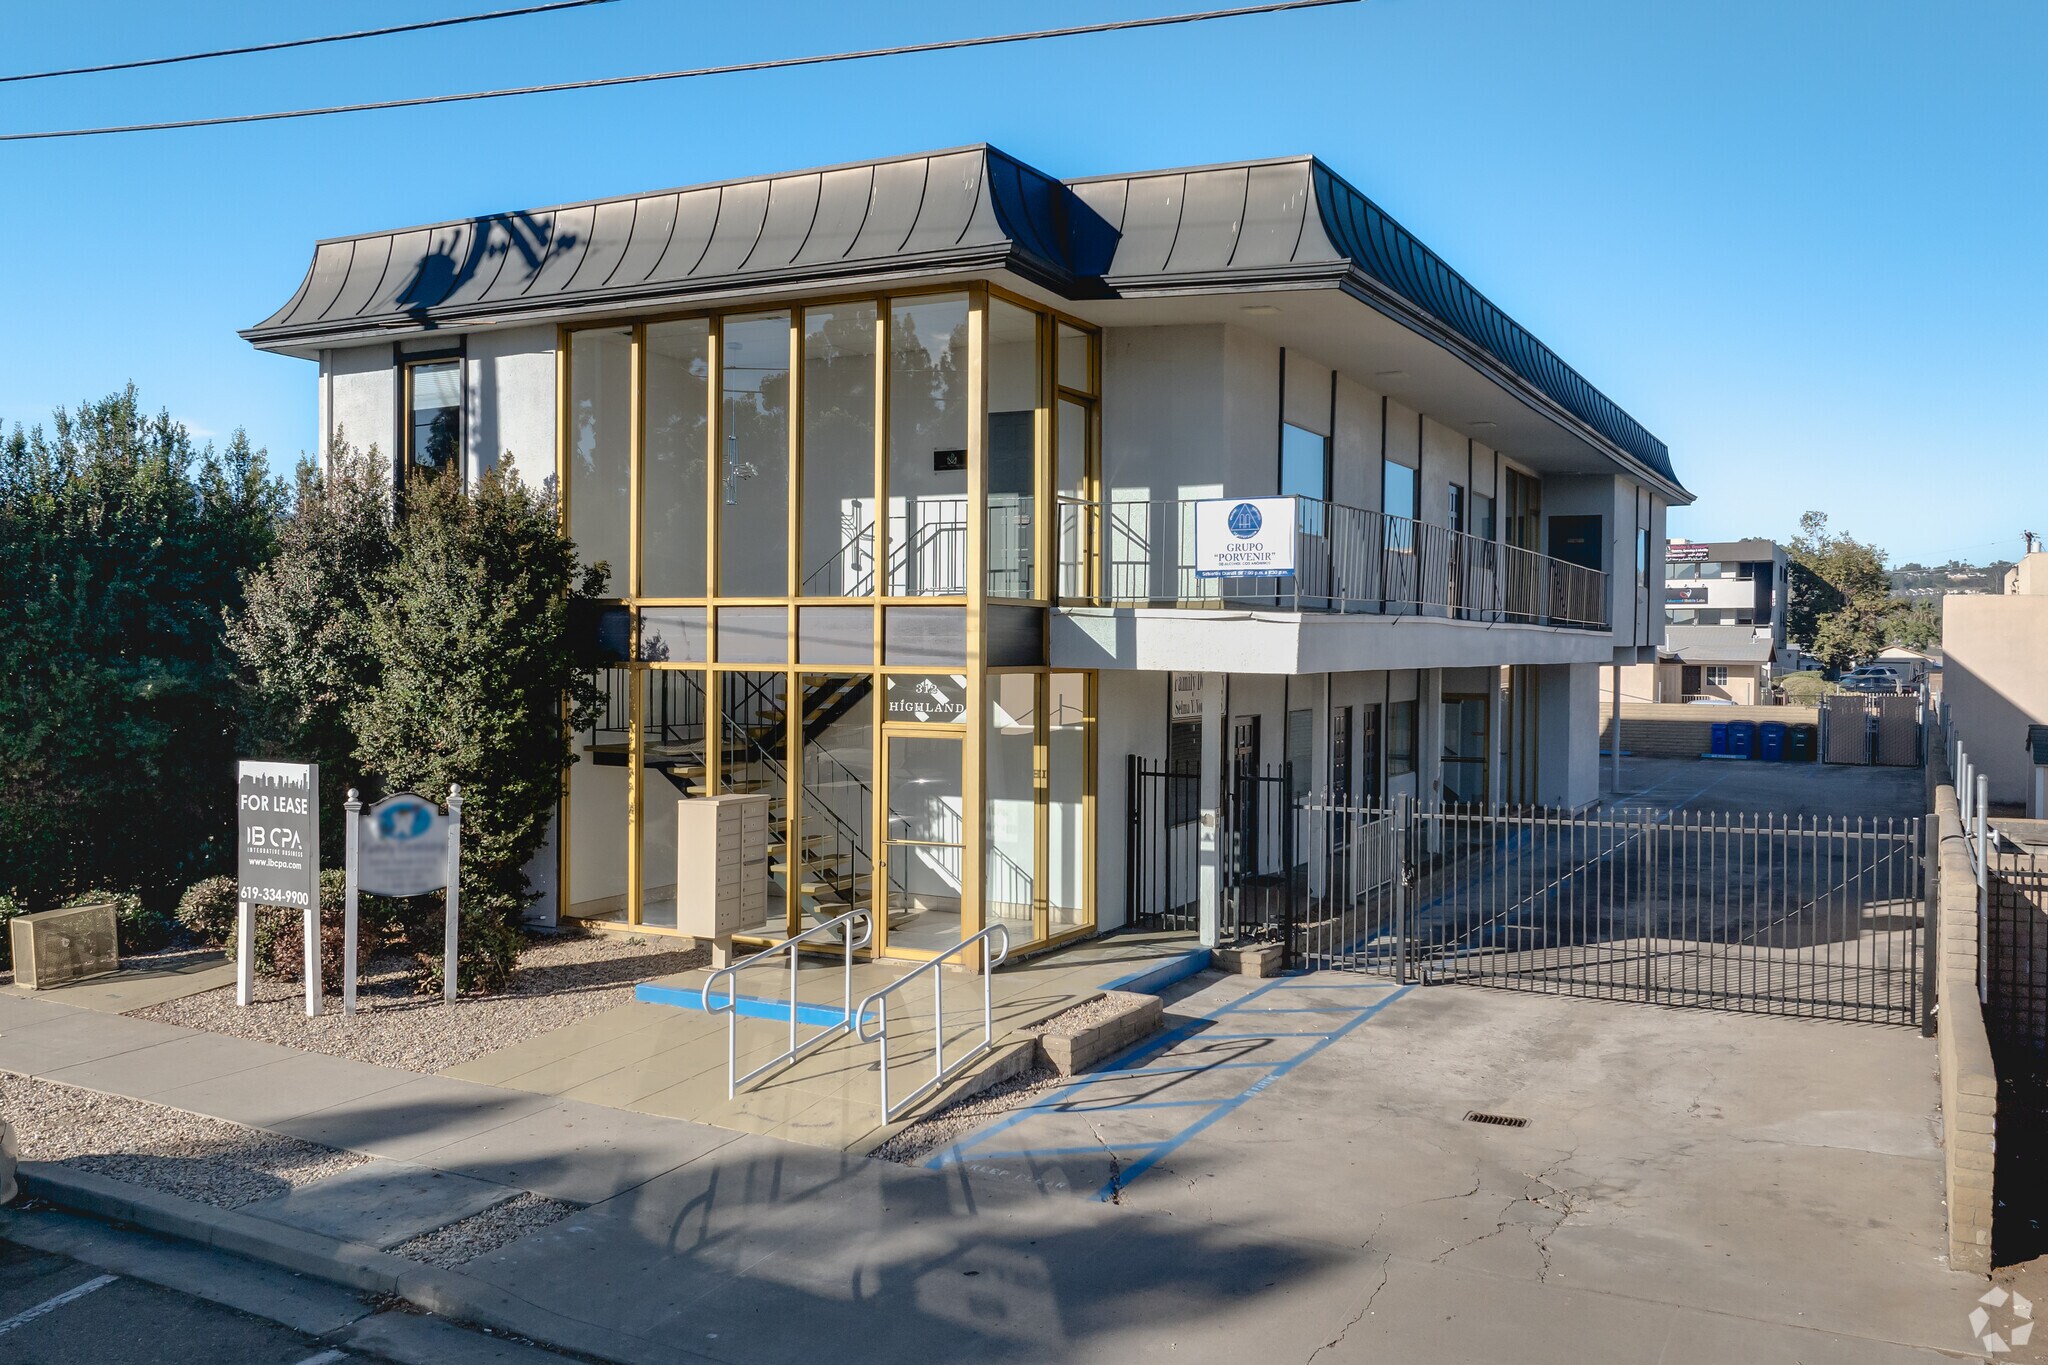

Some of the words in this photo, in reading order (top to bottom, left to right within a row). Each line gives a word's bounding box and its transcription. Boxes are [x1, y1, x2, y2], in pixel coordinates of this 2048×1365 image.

[1227, 543, 1263, 551] GRUPO
[915, 683, 937, 694] 312
[889, 701, 964, 712] HIGHLAND
[241, 794, 269, 811] FOR
[273, 796, 308, 815] LEASE
[247, 826, 265, 846] IB
[270, 827, 302, 850] CPA
[282, 849, 303, 858] BUSINESS
[248, 858, 302, 870] www.ibcpa.com
[240, 886, 308, 905] 619-334-9900
